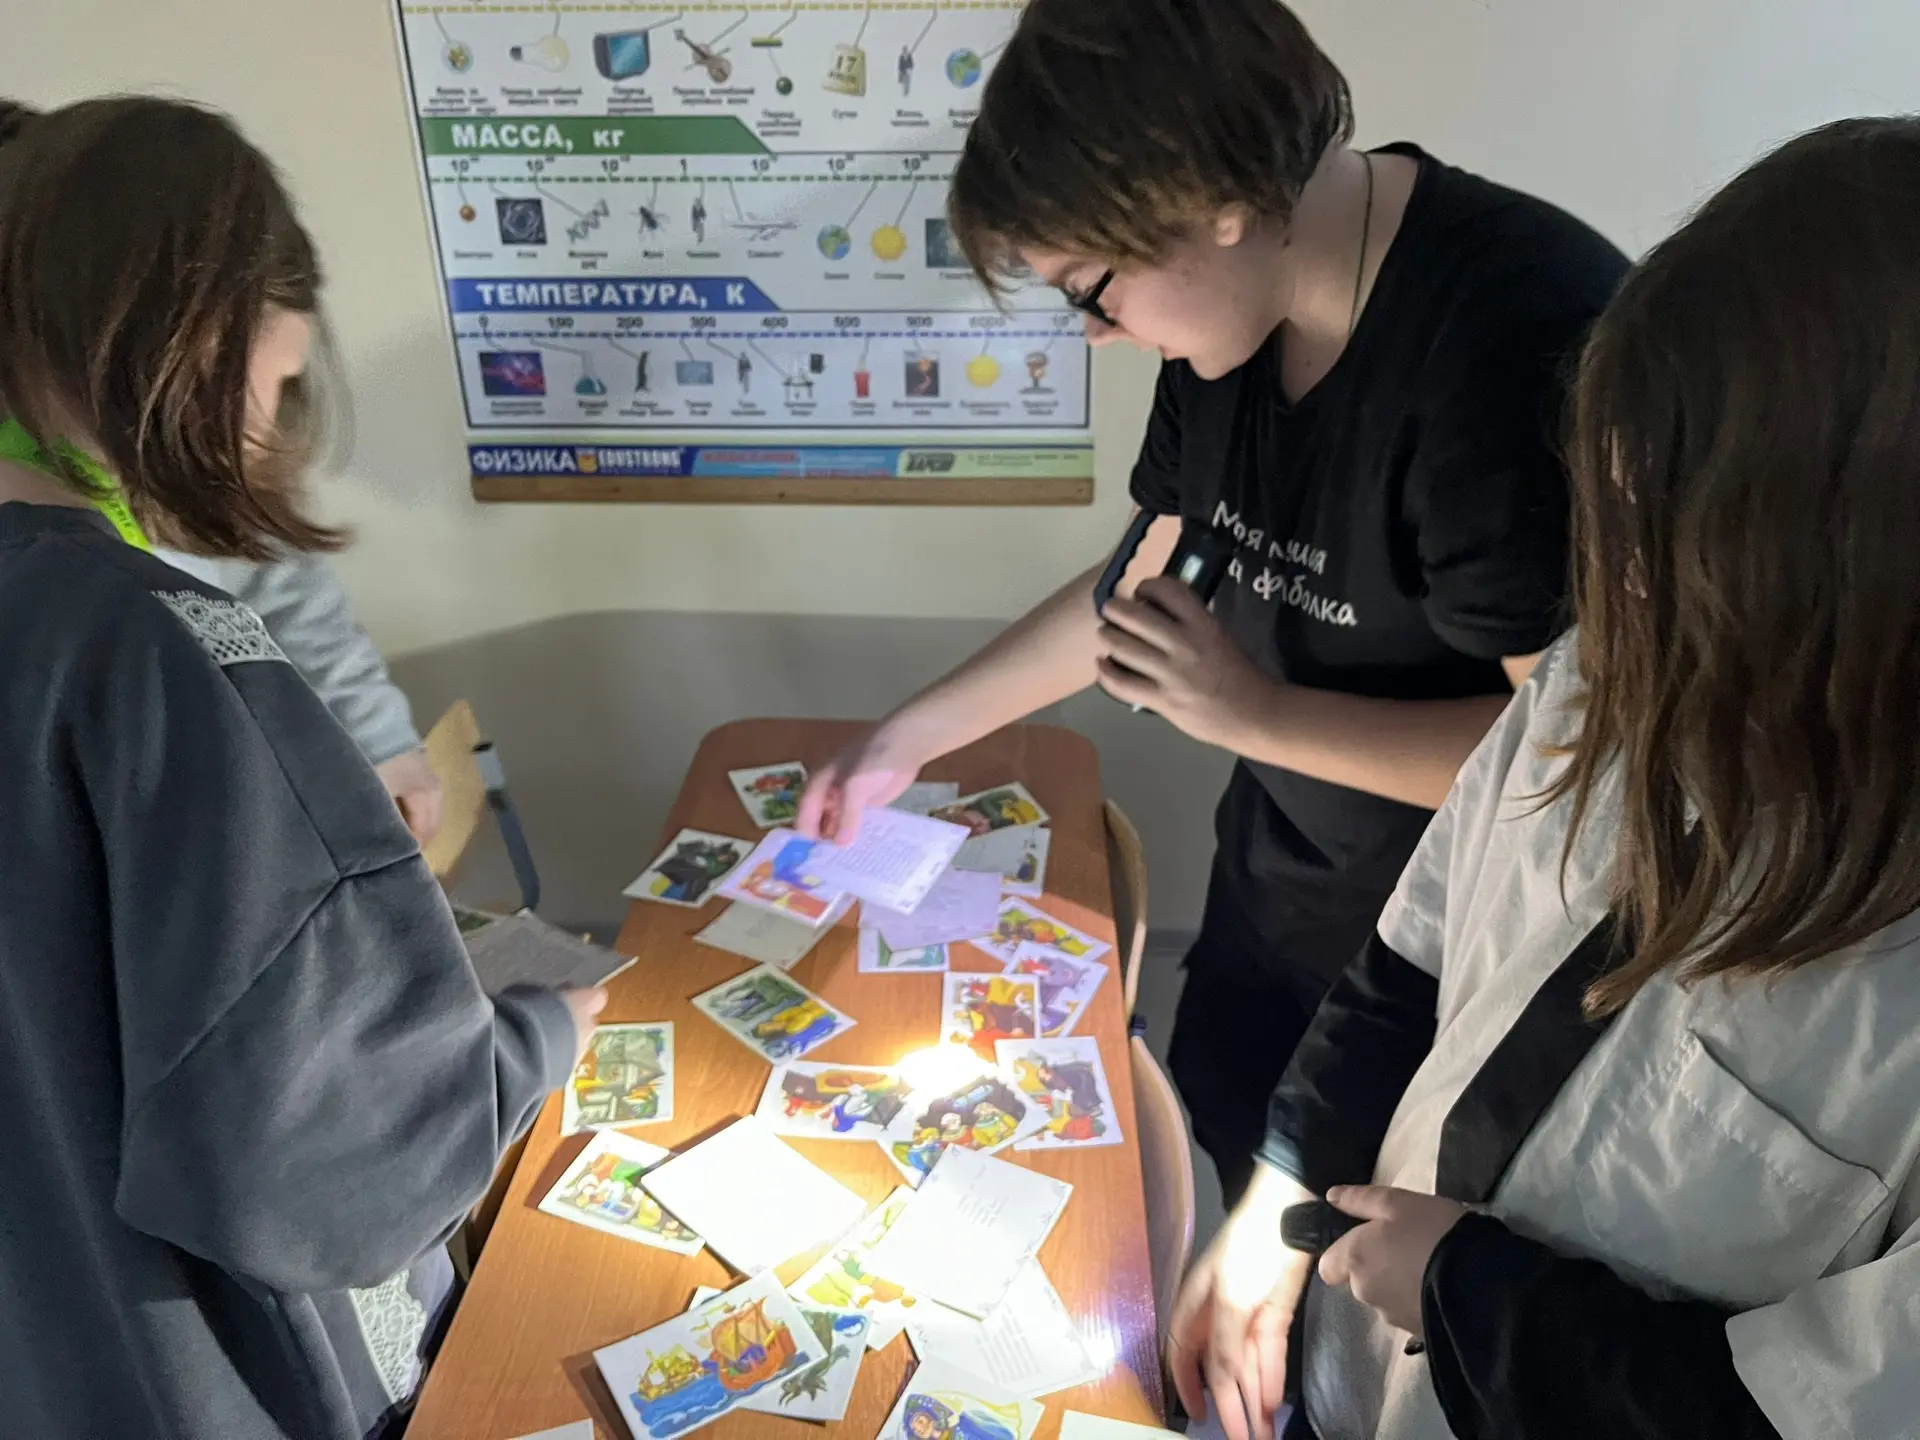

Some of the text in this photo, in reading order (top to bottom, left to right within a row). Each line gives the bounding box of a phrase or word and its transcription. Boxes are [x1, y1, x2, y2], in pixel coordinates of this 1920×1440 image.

[451, 124, 625, 153] МАССА, кг
[475, 283, 746, 308] ТЕМПЕРАТУРА, К
[473, 448, 577, 472] ФИЗИКА
[1212, 500, 1265, 551] Моя
